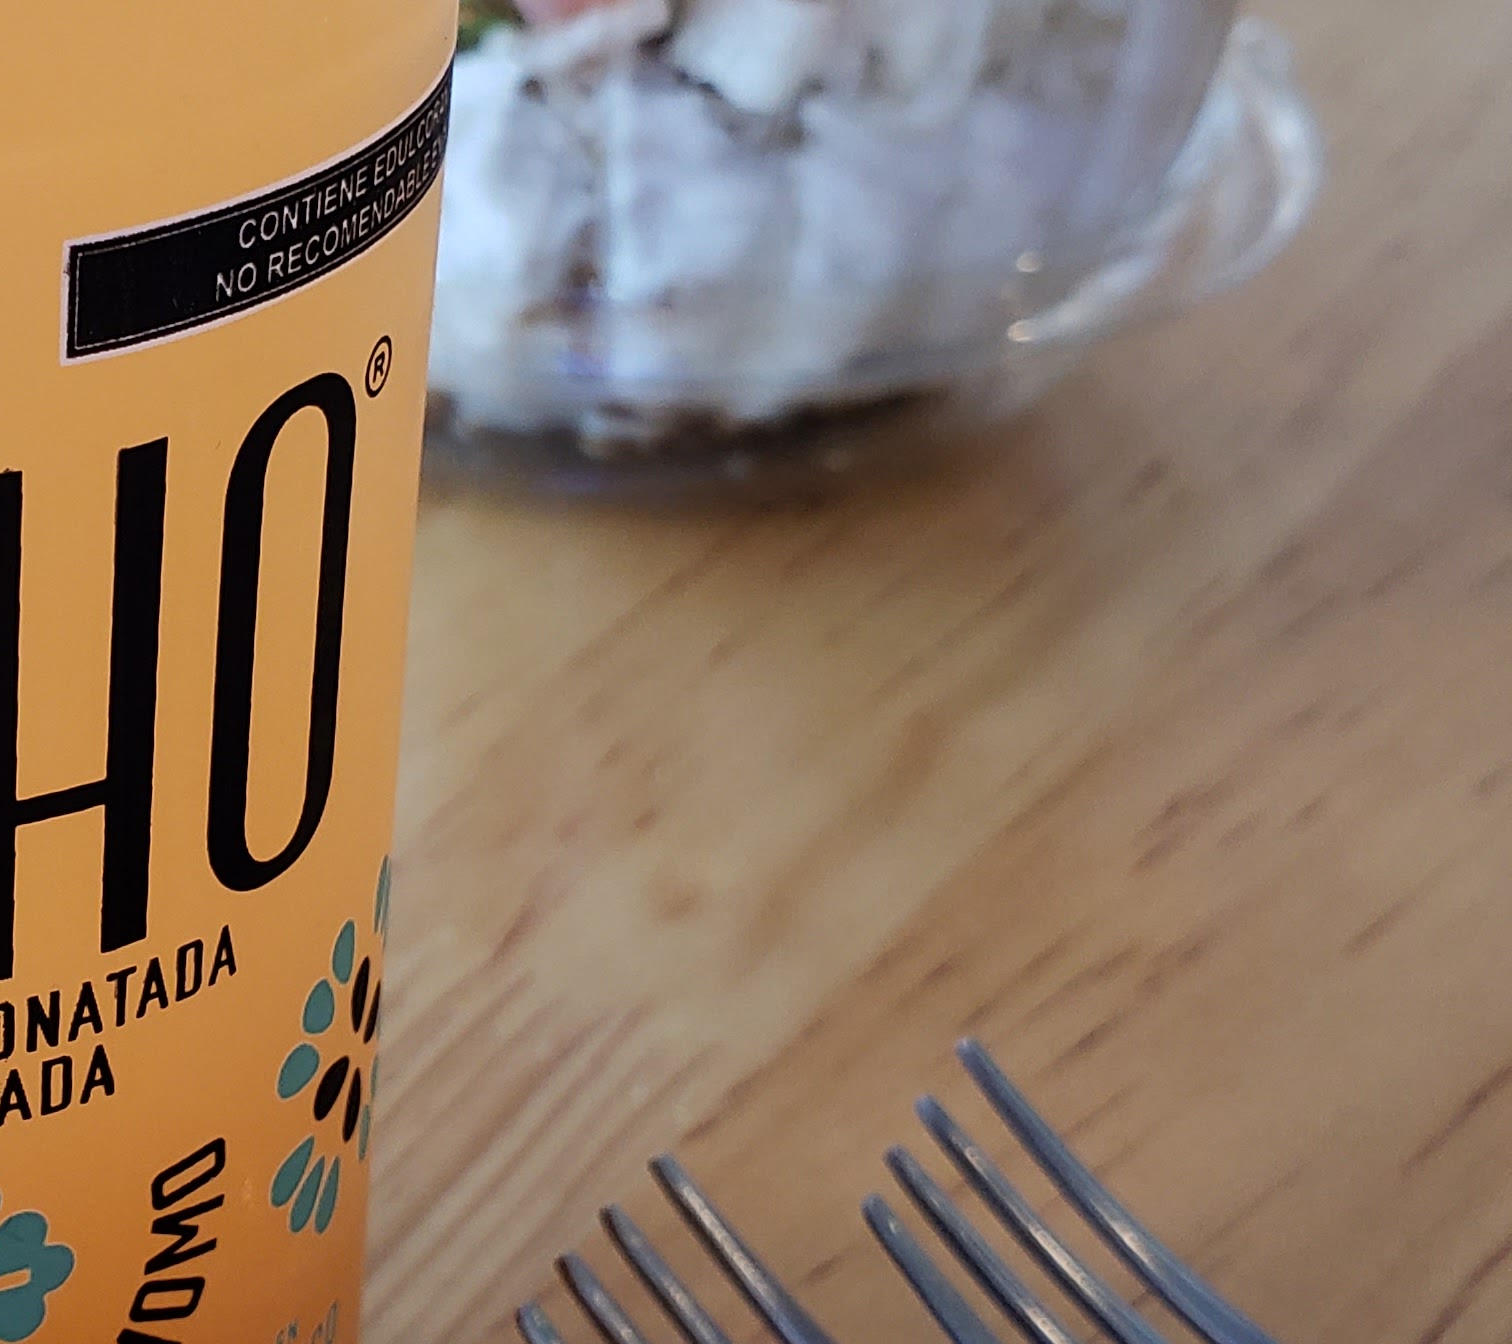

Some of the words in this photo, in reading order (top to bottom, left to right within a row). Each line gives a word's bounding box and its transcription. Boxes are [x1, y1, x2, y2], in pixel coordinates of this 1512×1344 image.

[215, 261, 257, 302] NO
[267, 149, 431, 283] RECOMENDABLE
[238, 165, 369, 249] CONTIENE
